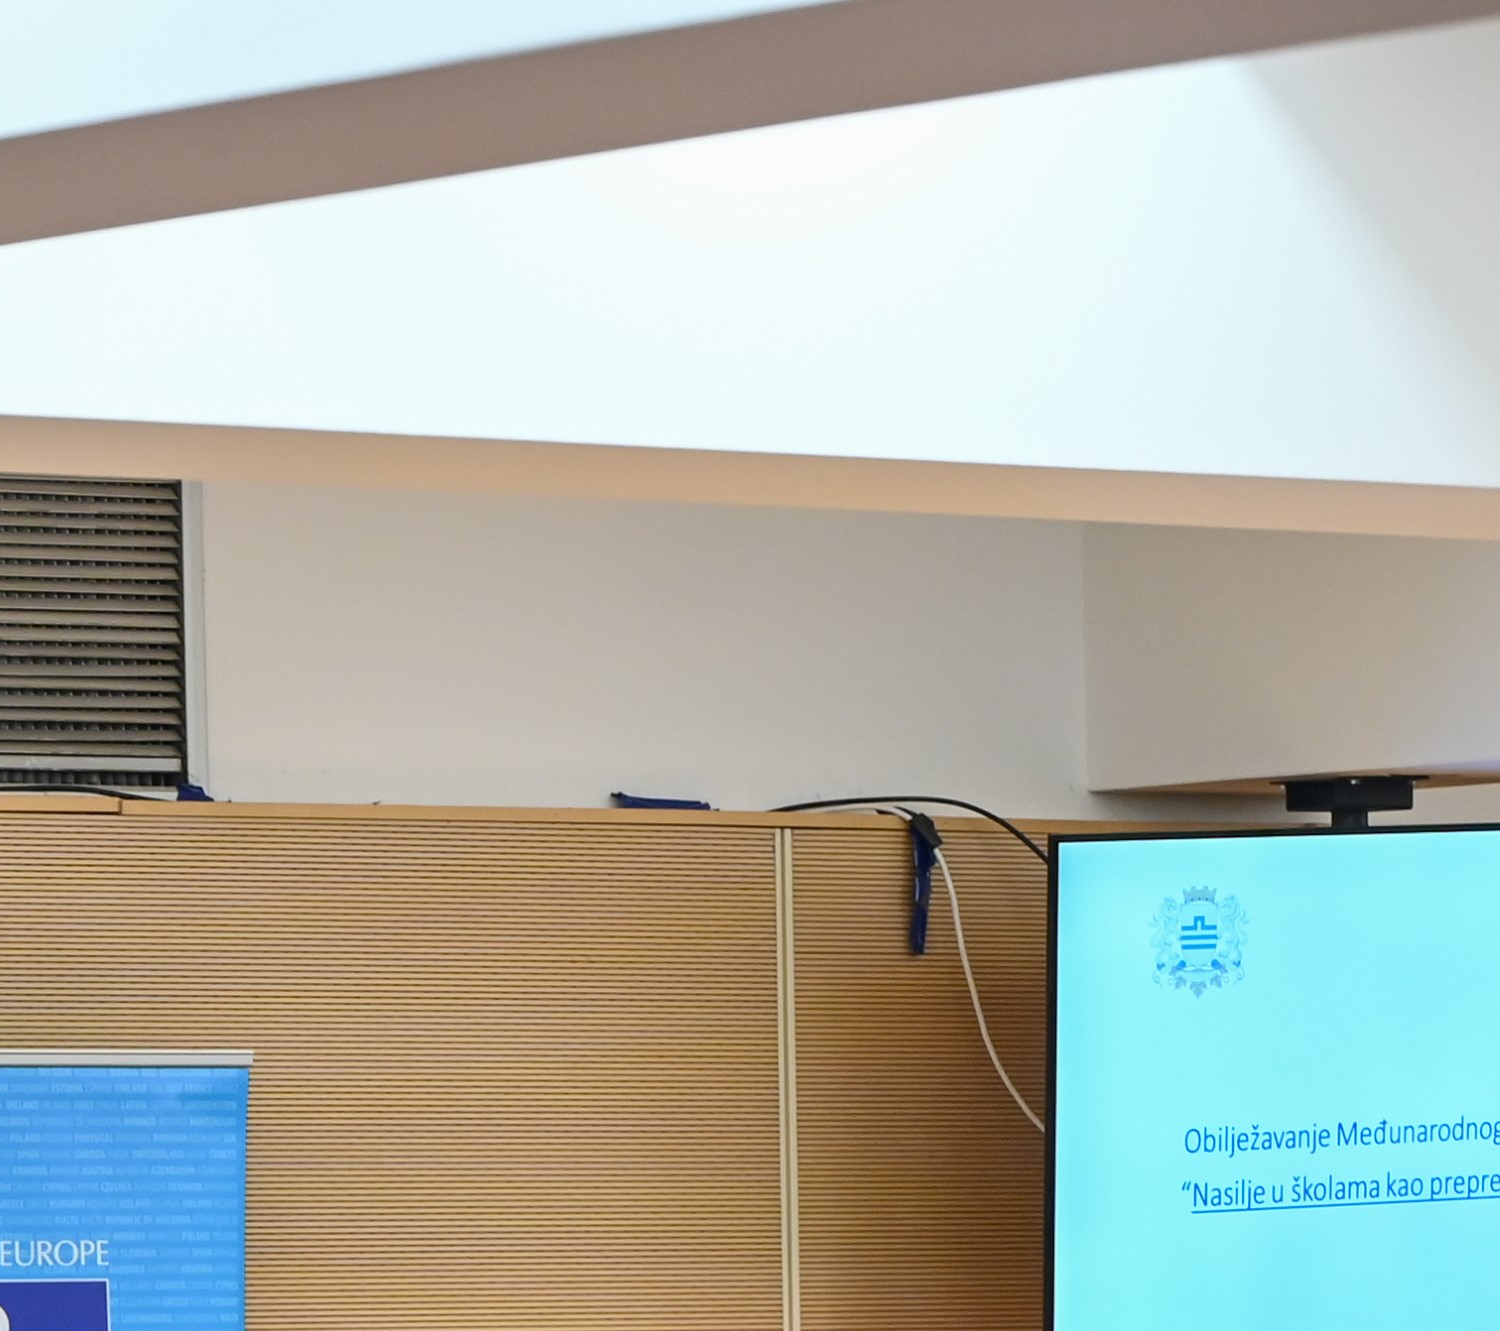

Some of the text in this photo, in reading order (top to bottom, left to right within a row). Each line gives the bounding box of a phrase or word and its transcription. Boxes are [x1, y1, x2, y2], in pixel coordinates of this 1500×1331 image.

[1184, 1124, 1331, 1157] Obilježavanje
[1272, 1185, 1283, 1204] u
[1291, 1175, 1381, 1203] školama
[1387, 1171, 1423, 1198] kao
[0, 1240, 109, 1267] EUROPE
